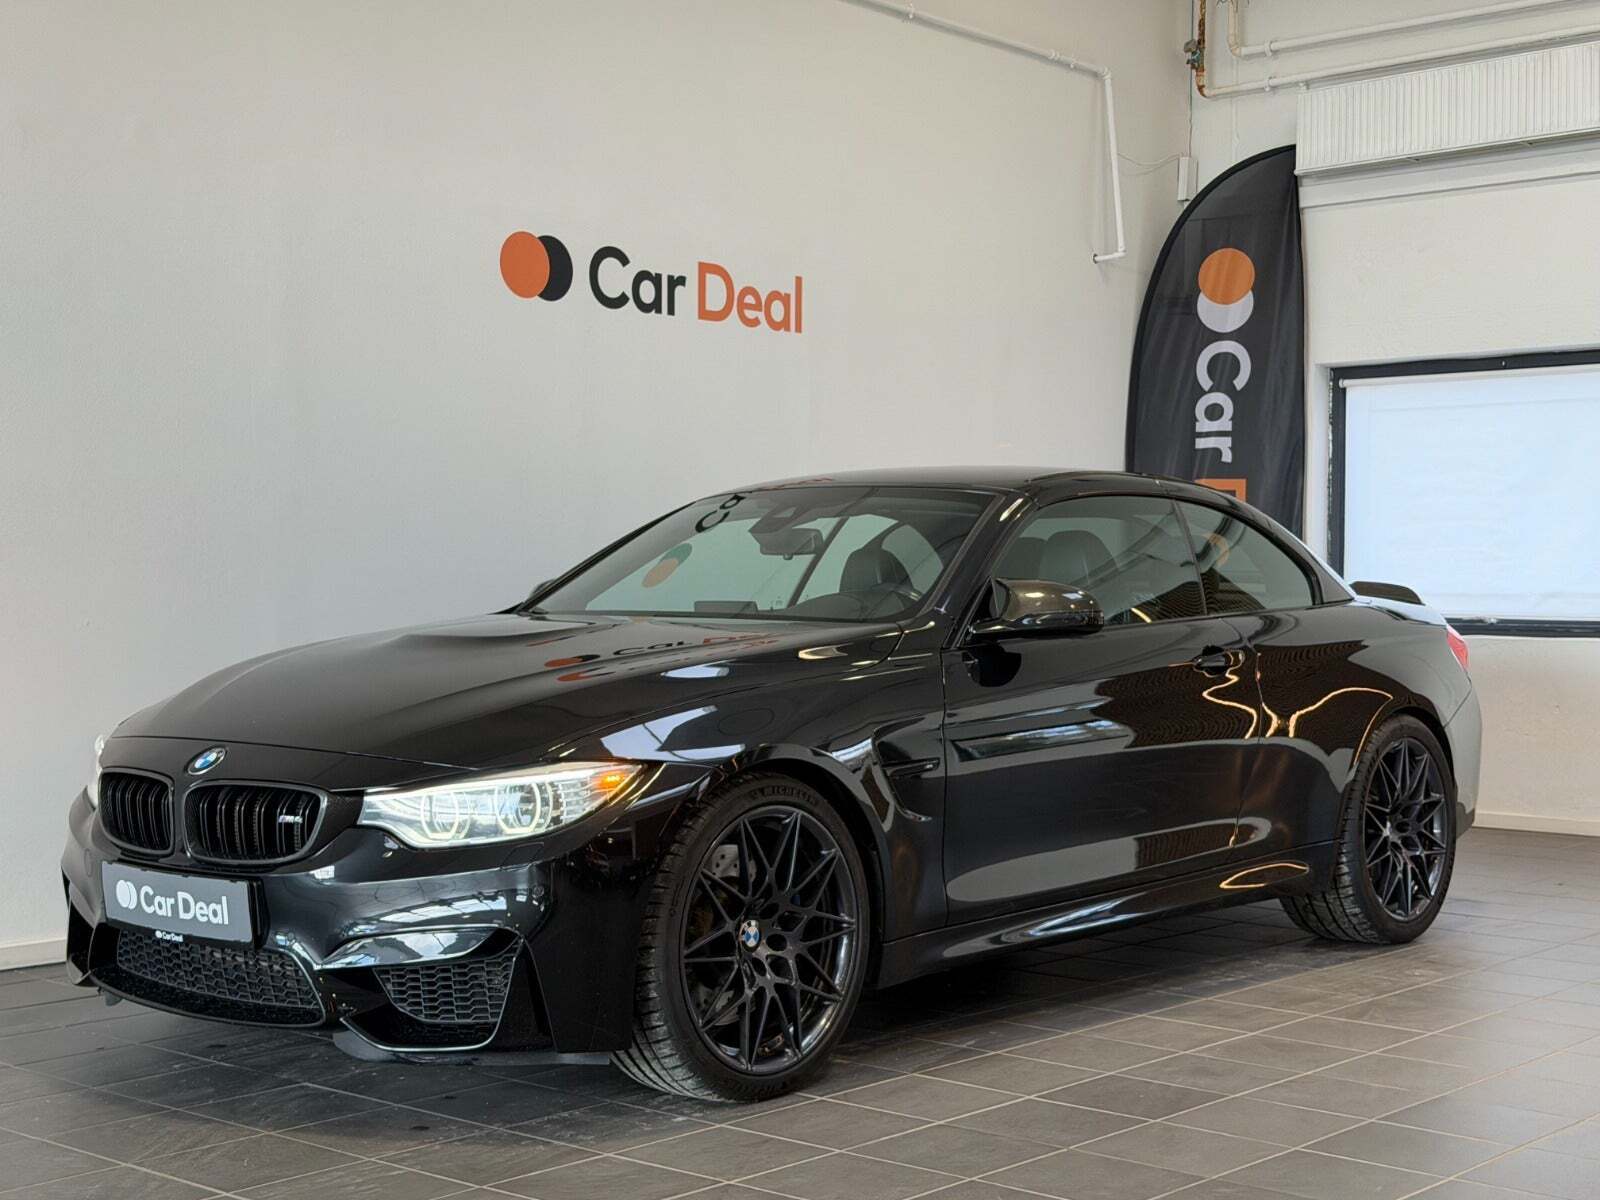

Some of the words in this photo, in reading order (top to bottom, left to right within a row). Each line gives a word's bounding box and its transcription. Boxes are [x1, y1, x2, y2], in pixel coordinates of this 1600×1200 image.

[589, 246, 687, 316] Car
[697, 260, 803, 334] Deal
[1195, 340, 1251, 463] Car
[140, 885, 175, 917] Car
[177, 891, 229, 925] Deal
